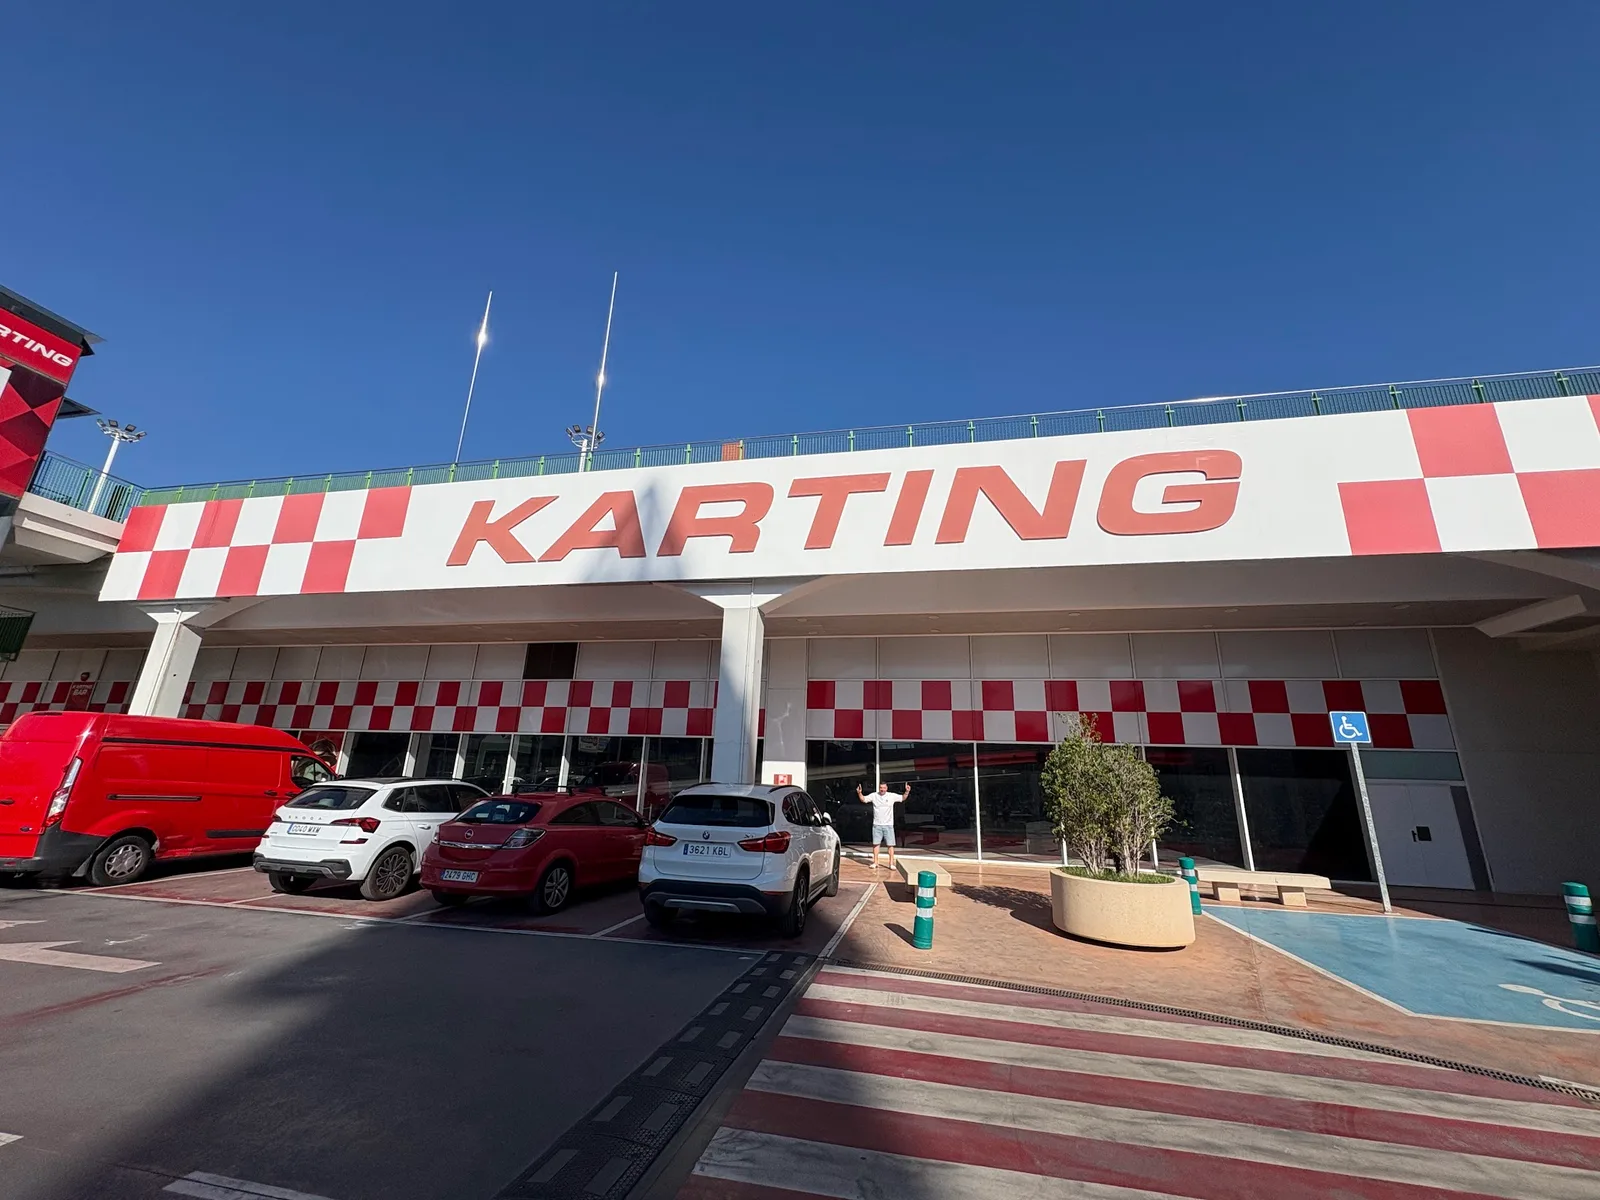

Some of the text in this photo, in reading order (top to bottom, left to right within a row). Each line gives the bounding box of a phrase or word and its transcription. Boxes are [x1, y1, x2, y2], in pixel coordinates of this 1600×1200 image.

[446, 449, 1243, 567] KARTING
[689, 844, 729, 856] 3621 KBL
[444, 870, 461, 880] 2479
